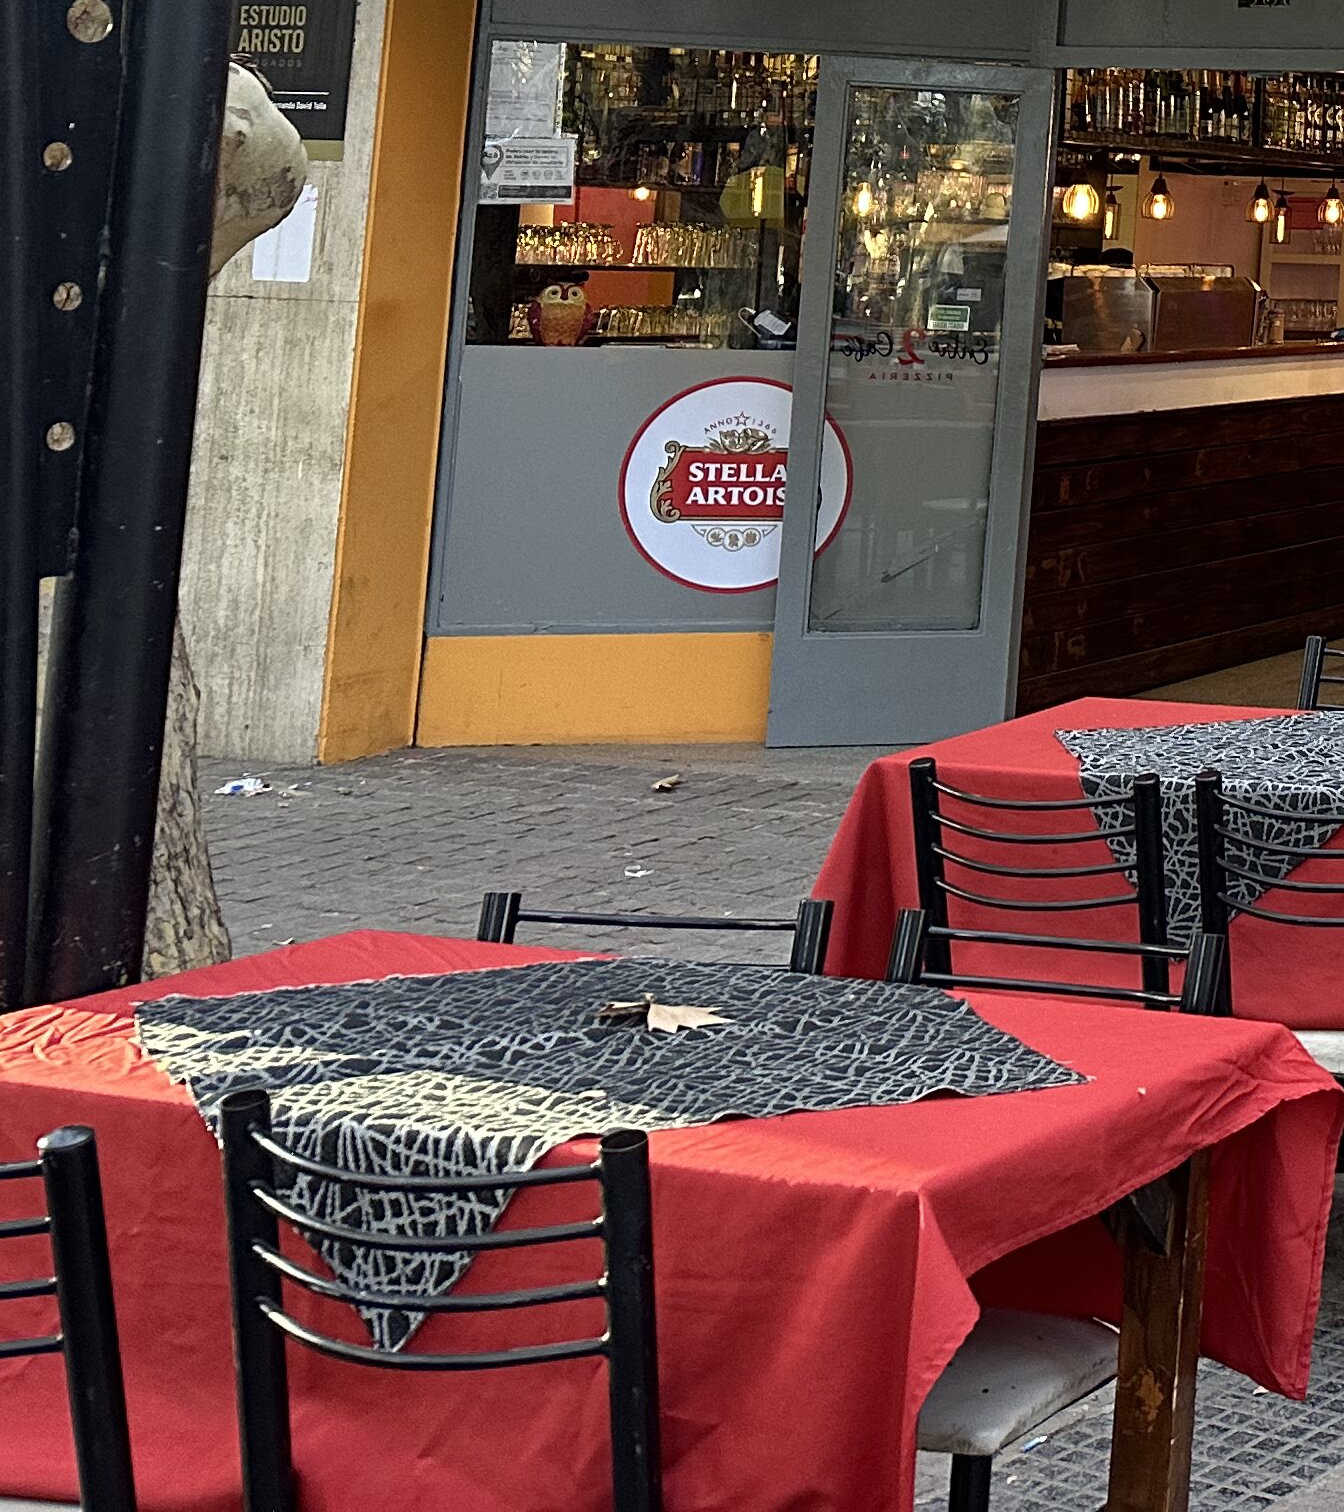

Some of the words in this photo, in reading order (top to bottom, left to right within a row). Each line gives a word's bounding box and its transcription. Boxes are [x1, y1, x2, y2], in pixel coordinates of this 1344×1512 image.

[240, 5, 307, 27] ESTUDIO
[238, 28, 305, 53] ARISTO
[704, 417, 733, 435] ANNO
[688, 462, 787, 482] STELLA
[685, 486, 785, 506] ARTOIS
